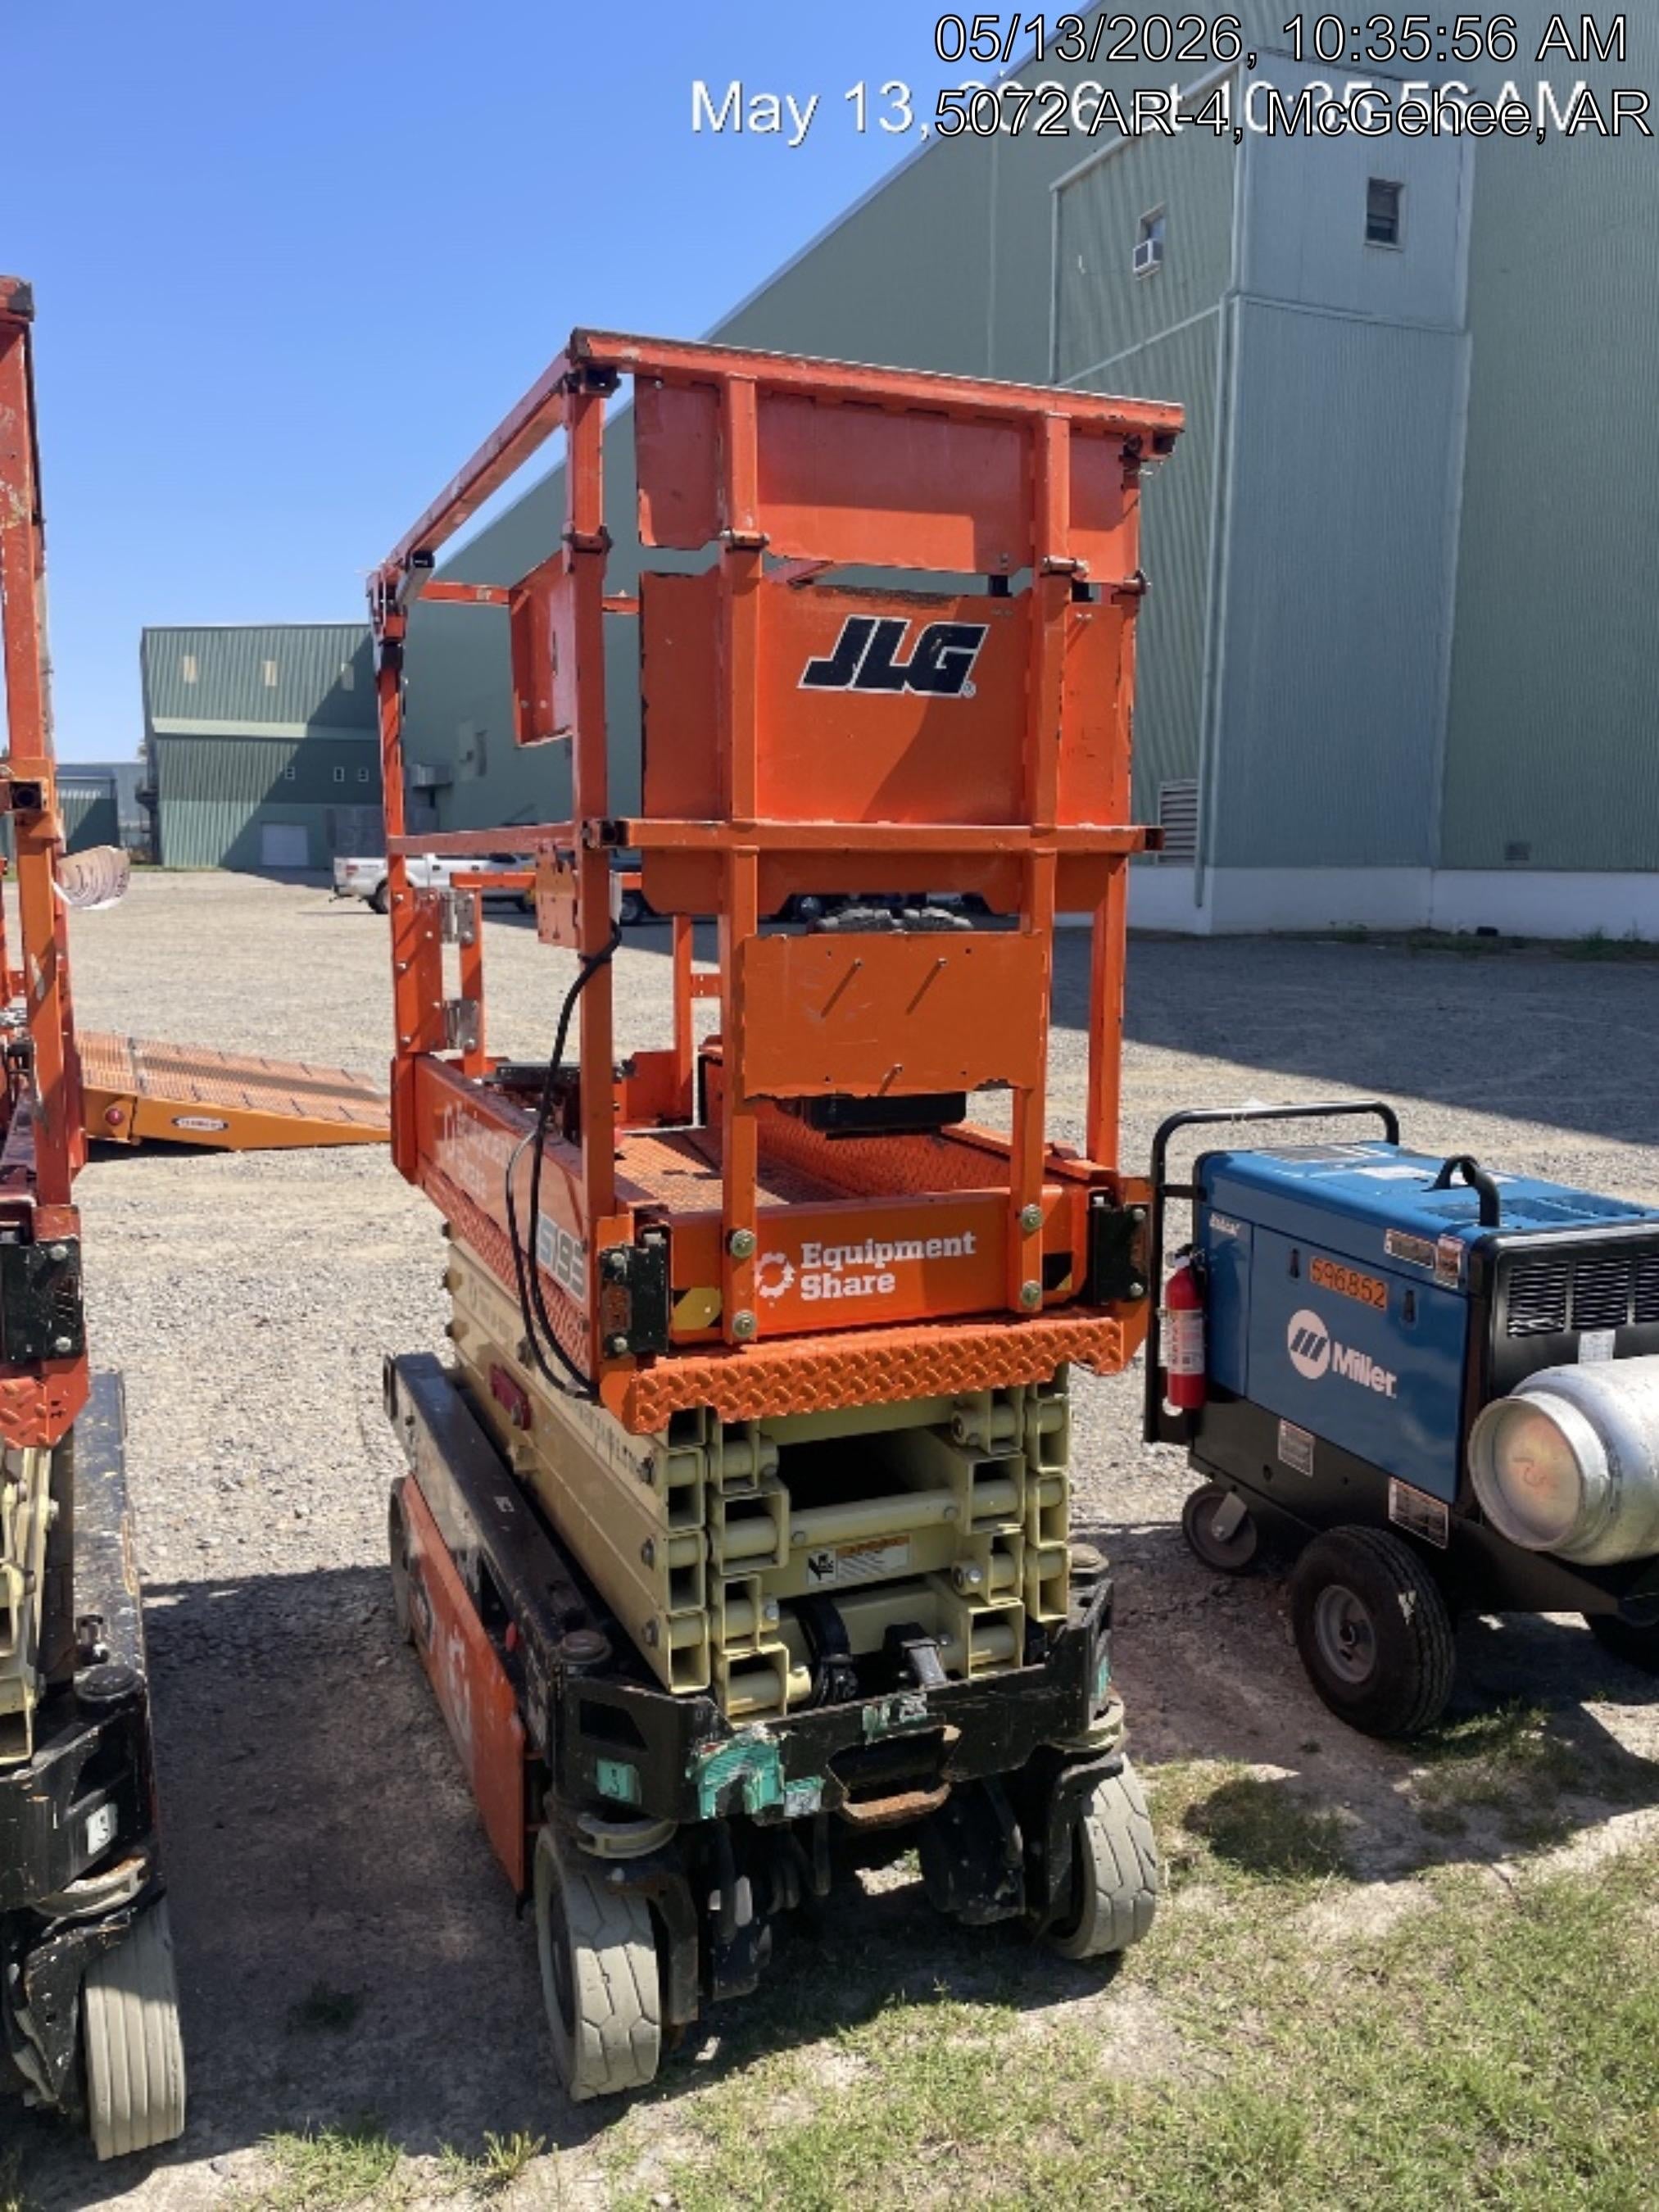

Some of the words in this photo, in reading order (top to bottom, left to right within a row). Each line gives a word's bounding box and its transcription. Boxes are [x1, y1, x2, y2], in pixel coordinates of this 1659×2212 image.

[796, 614, 990, 698] JLG
[800, 1231, 977, 1272] Equipment
[800, 1271, 896, 1301] Share
[1312, 1258, 1385, 1309] 596852
[1332, 1341, 1397, 1398] Miller
